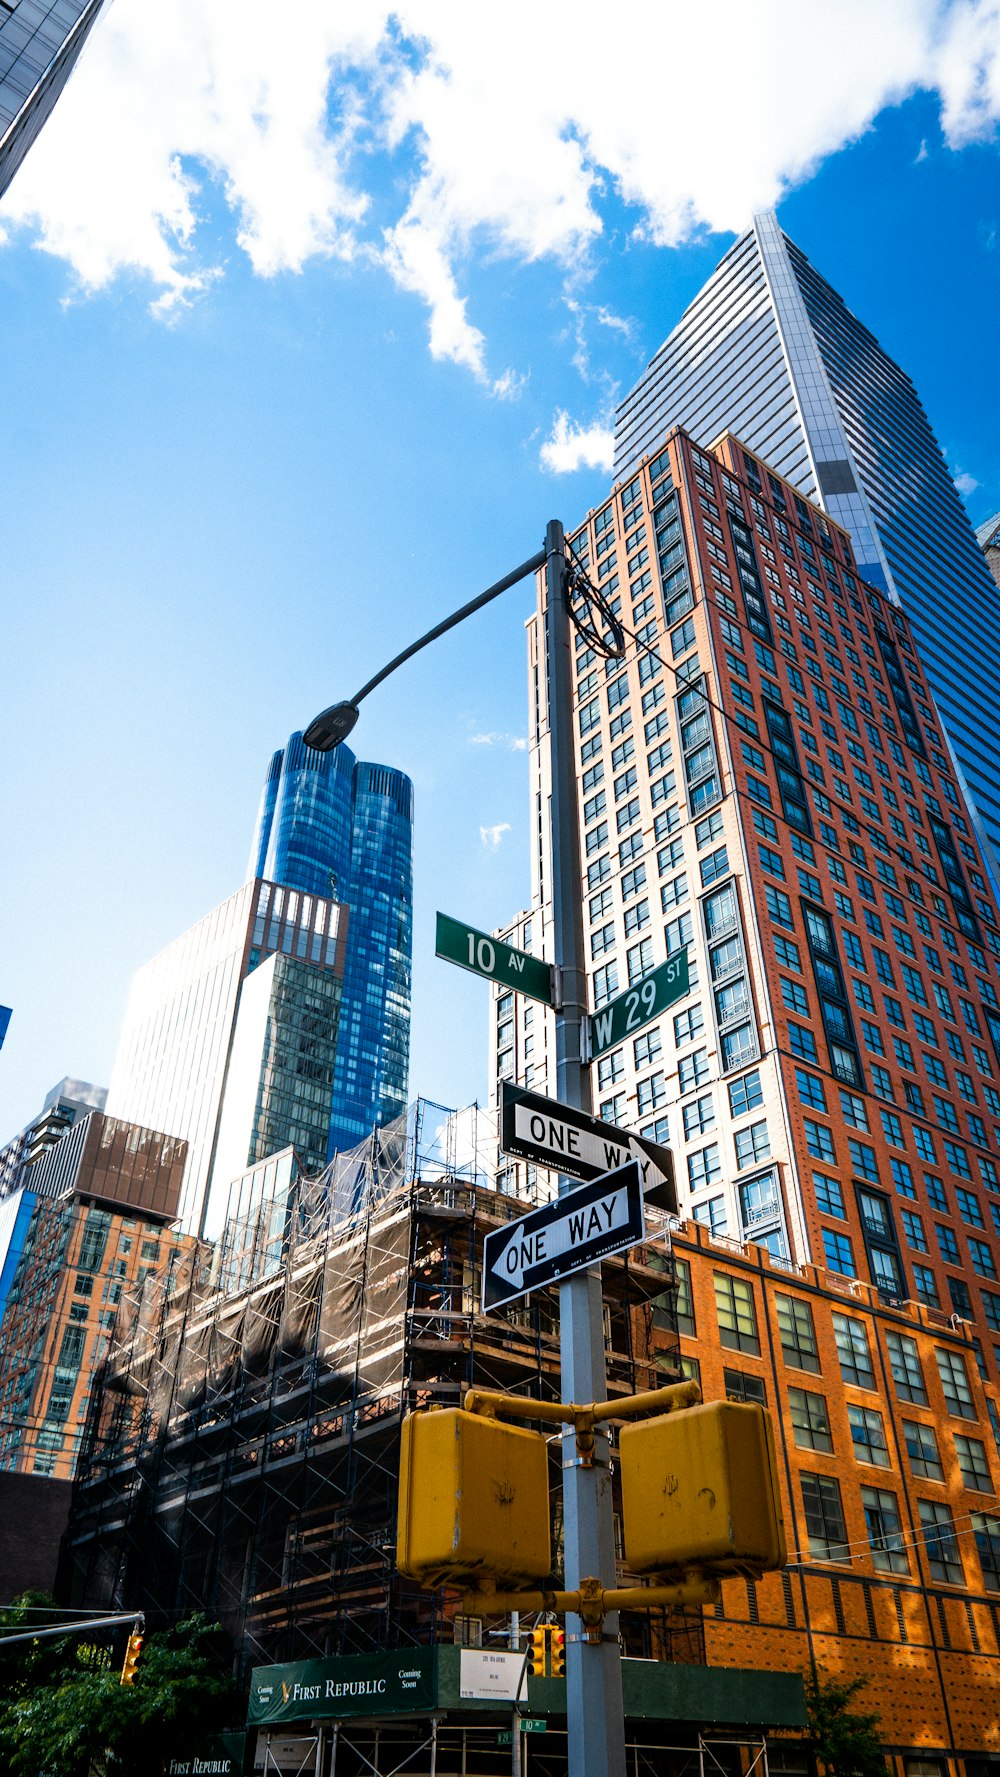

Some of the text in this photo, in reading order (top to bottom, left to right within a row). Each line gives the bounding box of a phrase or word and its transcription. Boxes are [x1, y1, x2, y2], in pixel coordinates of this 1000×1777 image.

[467, 933, 525, 973] 10 AV
[595, 957, 682, 1050] W 29 ST
[530, 1115, 581, 1158] ONE
[538, 1157, 581, 1176] TRANSPORTATION
[506, 1195, 617, 1274] ONE WAY
[595, 1235, 636, 1256] TRANSPORTATION
[398, 1668, 422, 1680] Coming
[257, 1685, 274, 1695] Coming
[401, 1680, 417, 1689] Soon
[259, 1695, 270, 1704] Soon
